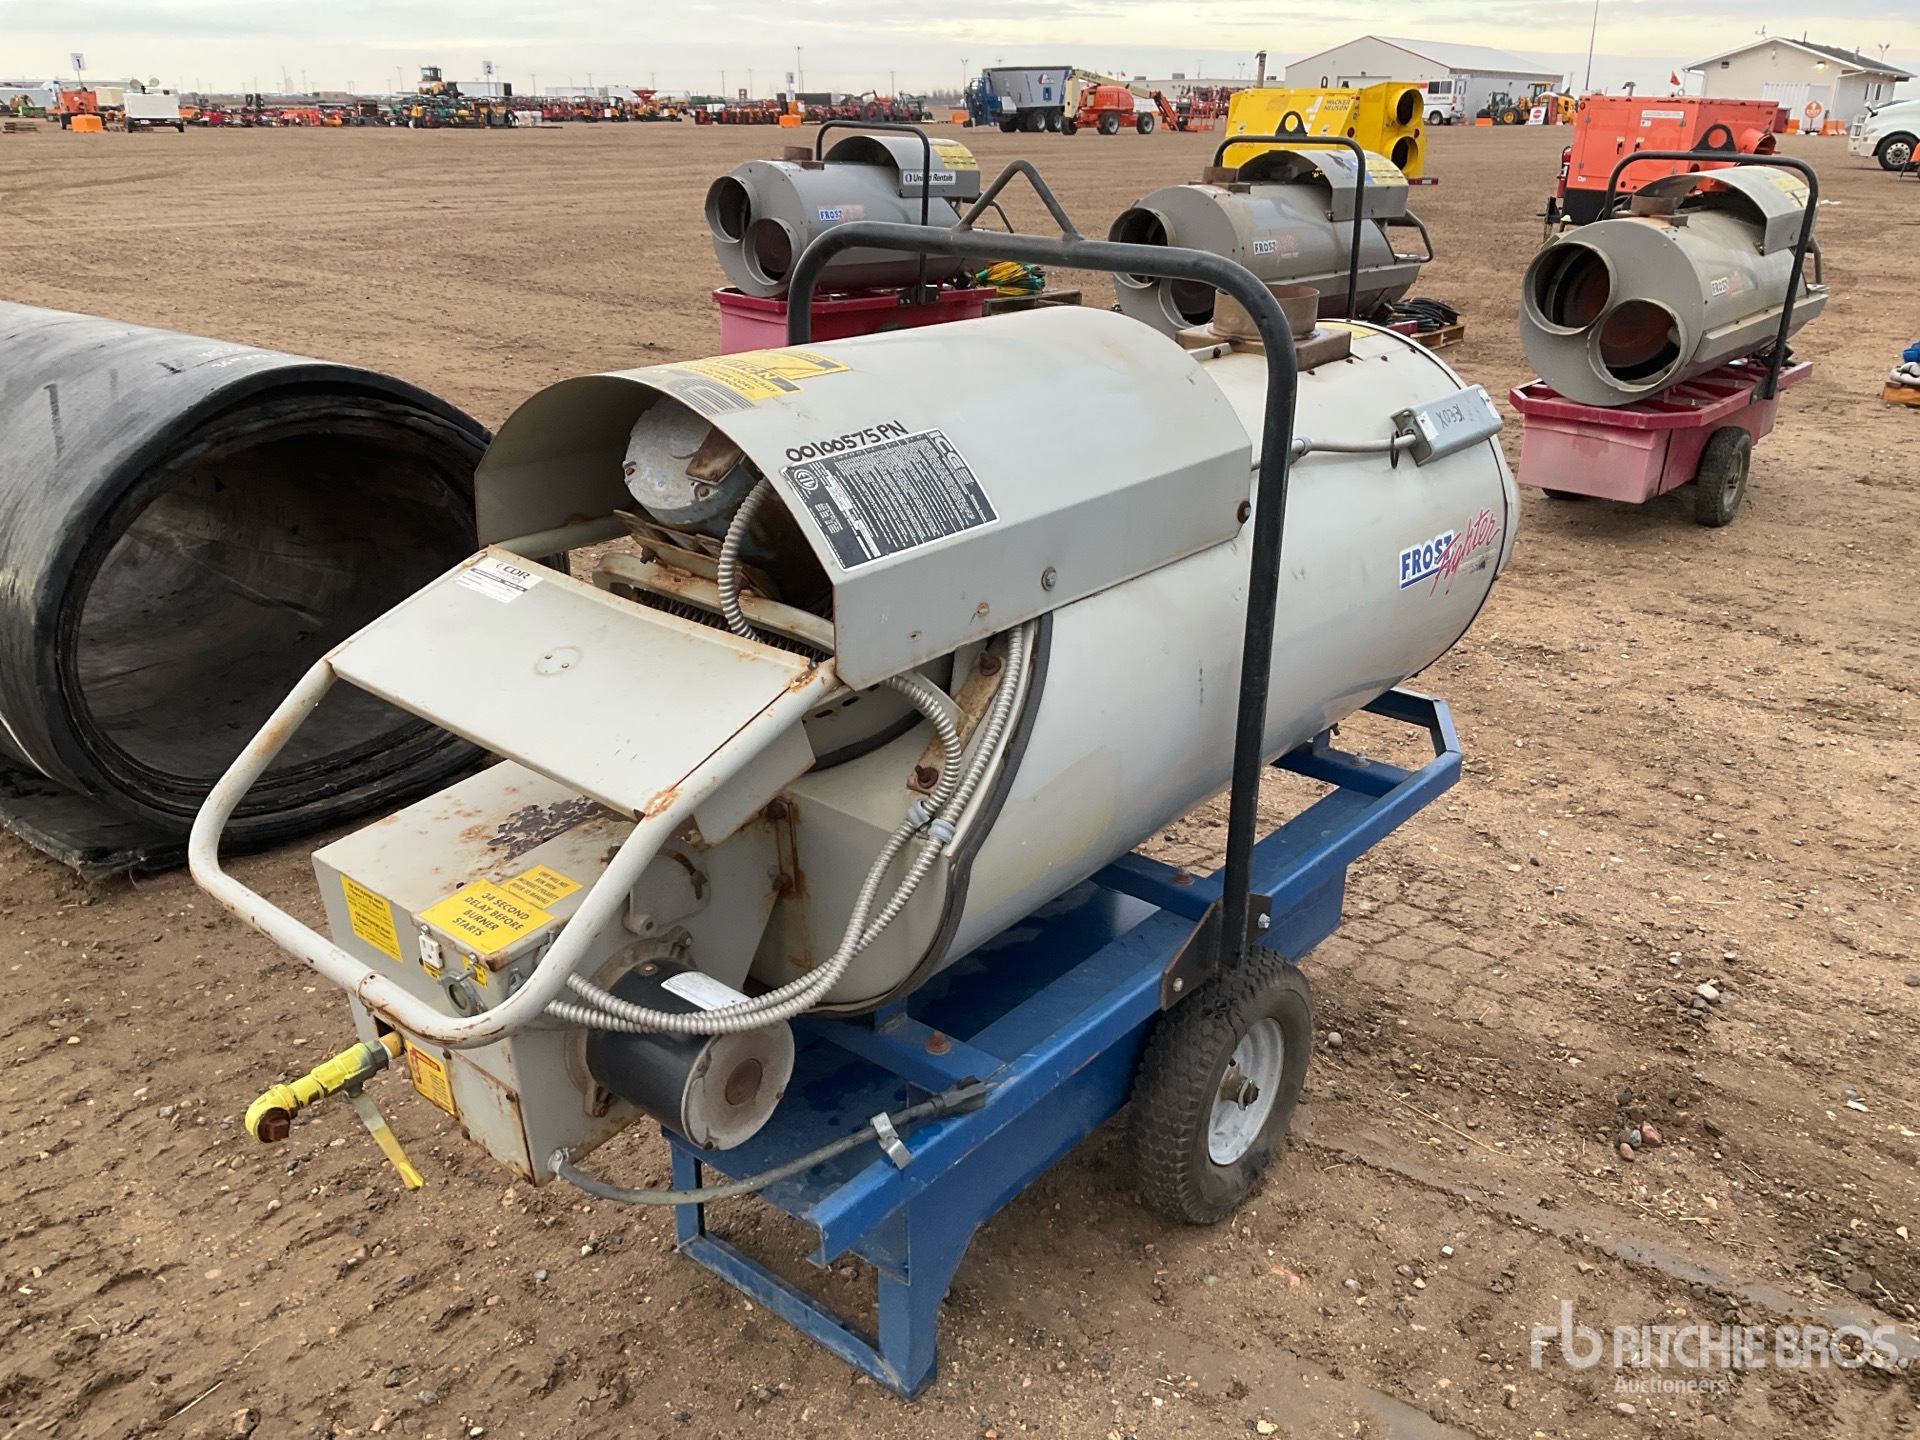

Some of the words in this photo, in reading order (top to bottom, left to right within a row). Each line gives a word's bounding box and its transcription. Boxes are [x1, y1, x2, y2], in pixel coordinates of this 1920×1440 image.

[933, 173, 953, 182] Rentals
[785, 420, 909, 463] 00100575PN
[1401, 534, 1452, 582] FROST
[463, 909, 499, 931] BURNER
[464, 896, 493, 913] DELAY
[490, 909, 524, 931] BEFORE
[481, 892, 496, 901] 34
[493, 899, 530, 920] SECOND
[452, 917, 485, 936] STARTS
